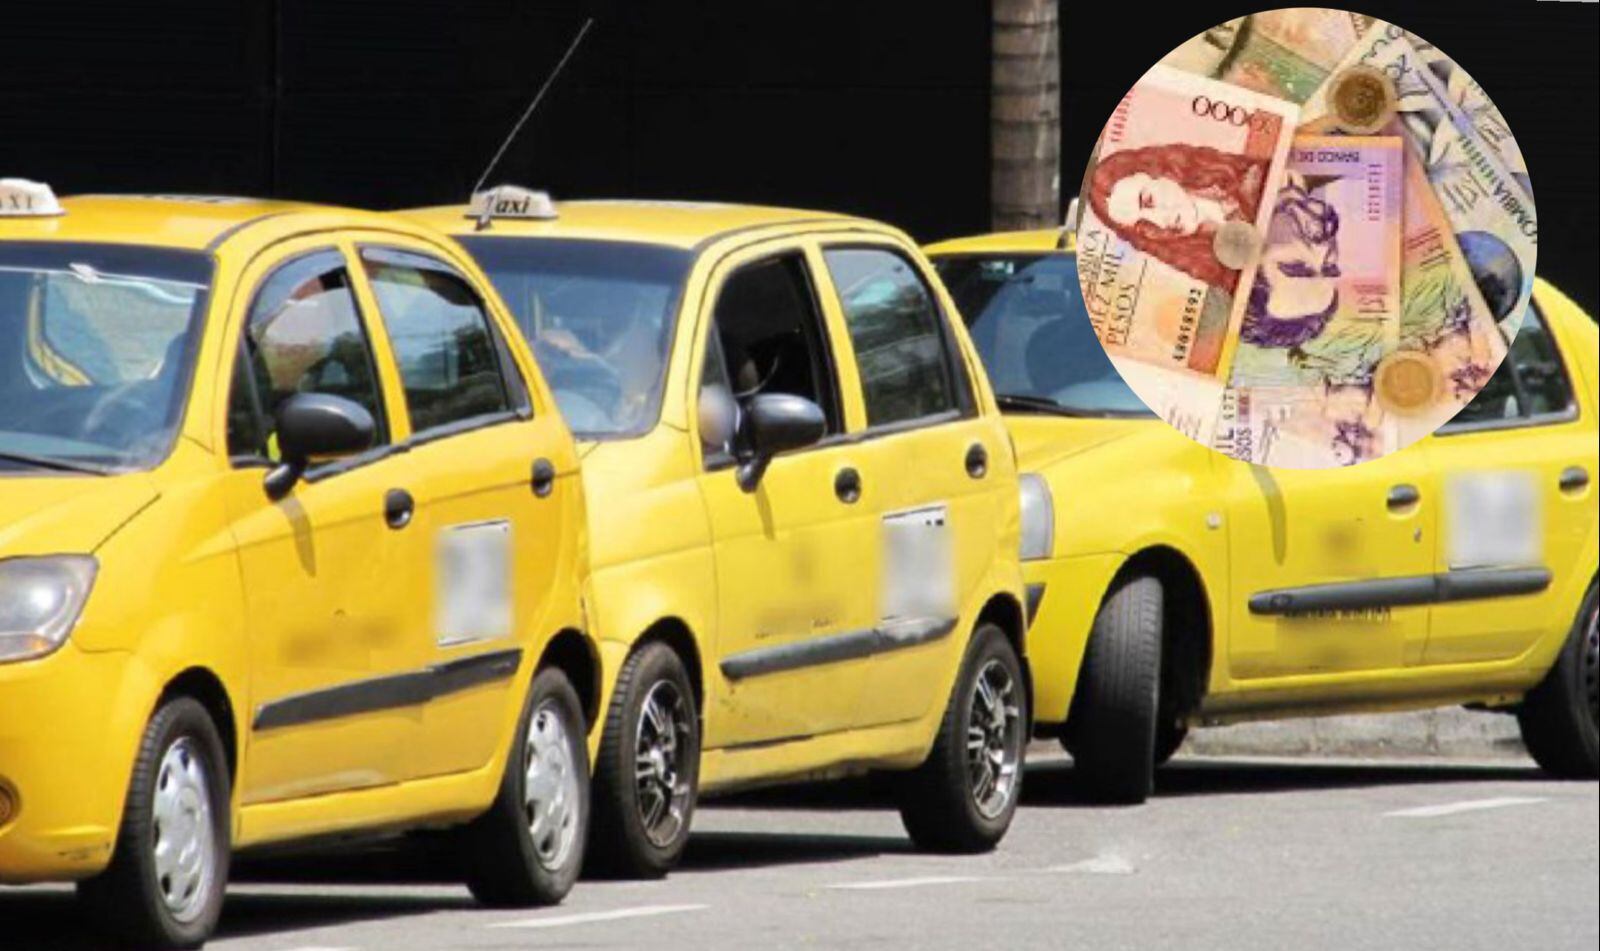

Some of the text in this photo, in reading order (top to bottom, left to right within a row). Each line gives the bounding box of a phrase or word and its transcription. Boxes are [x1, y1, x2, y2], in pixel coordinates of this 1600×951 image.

[0, 192, 33, 209] XI
[1494, 180, 1537, 243] OMBIA
[1100, 251, 1124, 287] MIL
[1106, 283, 1135, 344] PESOS
